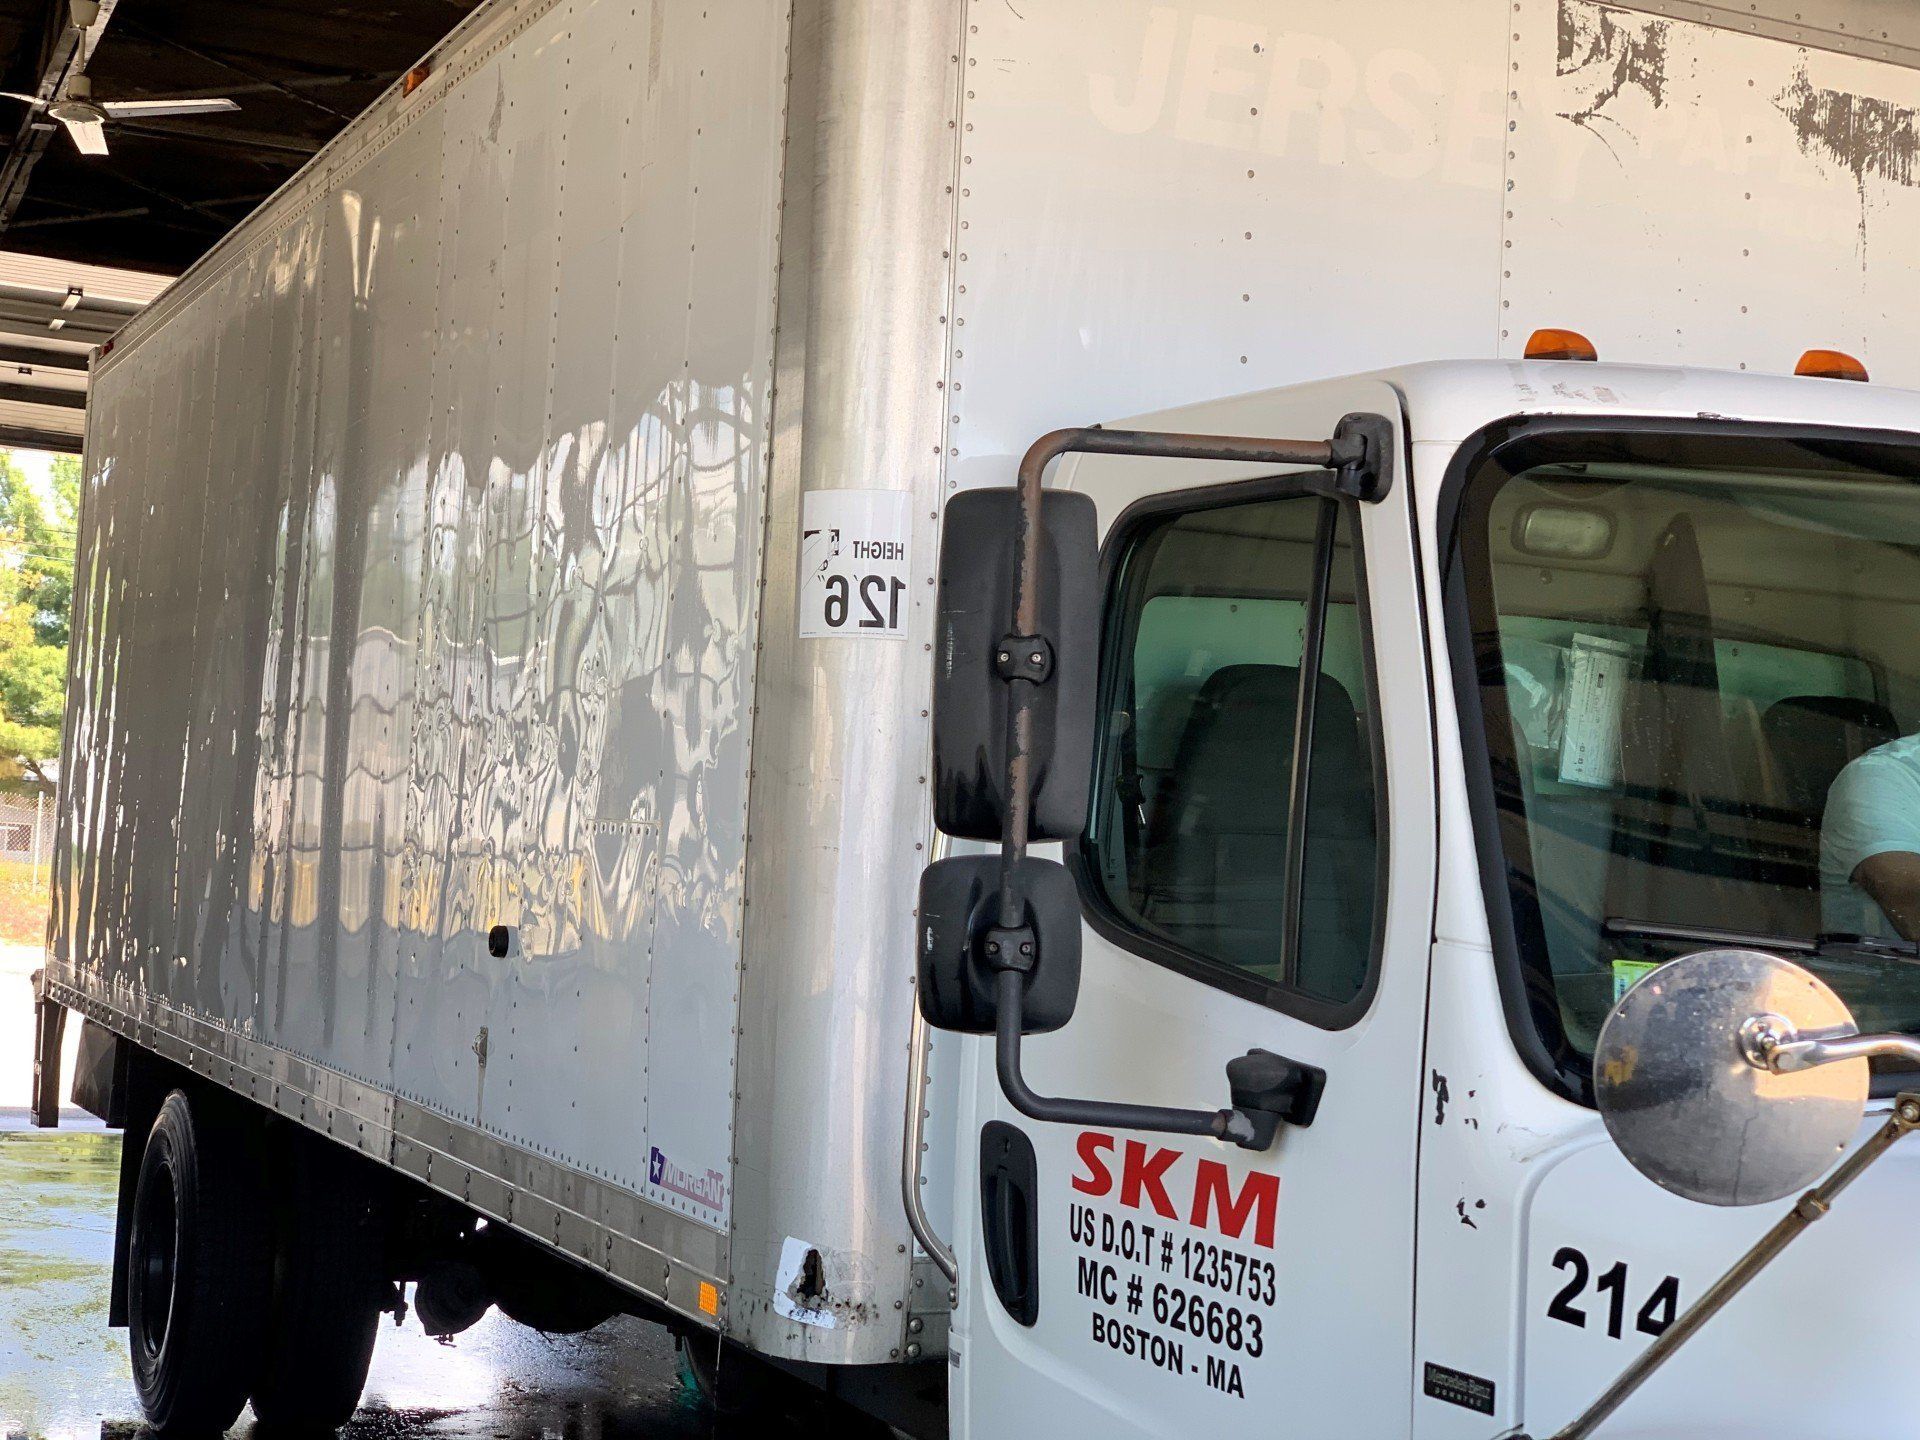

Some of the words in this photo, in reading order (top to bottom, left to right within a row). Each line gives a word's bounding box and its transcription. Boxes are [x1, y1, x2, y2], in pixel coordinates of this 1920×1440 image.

[1071, 1131, 1281, 1250] SKM
[1069, 1203, 1096, 1247] US
[1101, 1212, 1155, 1266] D.O.T
[1160, 1230, 1174, 1273] #
[1181, 1237, 1276, 1307] 1235753
[1077, 1255, 1118, 1306] MC
[1126, 1273, 1143, 1315] #
[1152, 1282, 1263, 1359] 626683
[1547, 1246, 1679, 1340] 214
[1092, 1311, 1184, 1375] BOSTON
[1206, 1354, 1245, 1400] MA
